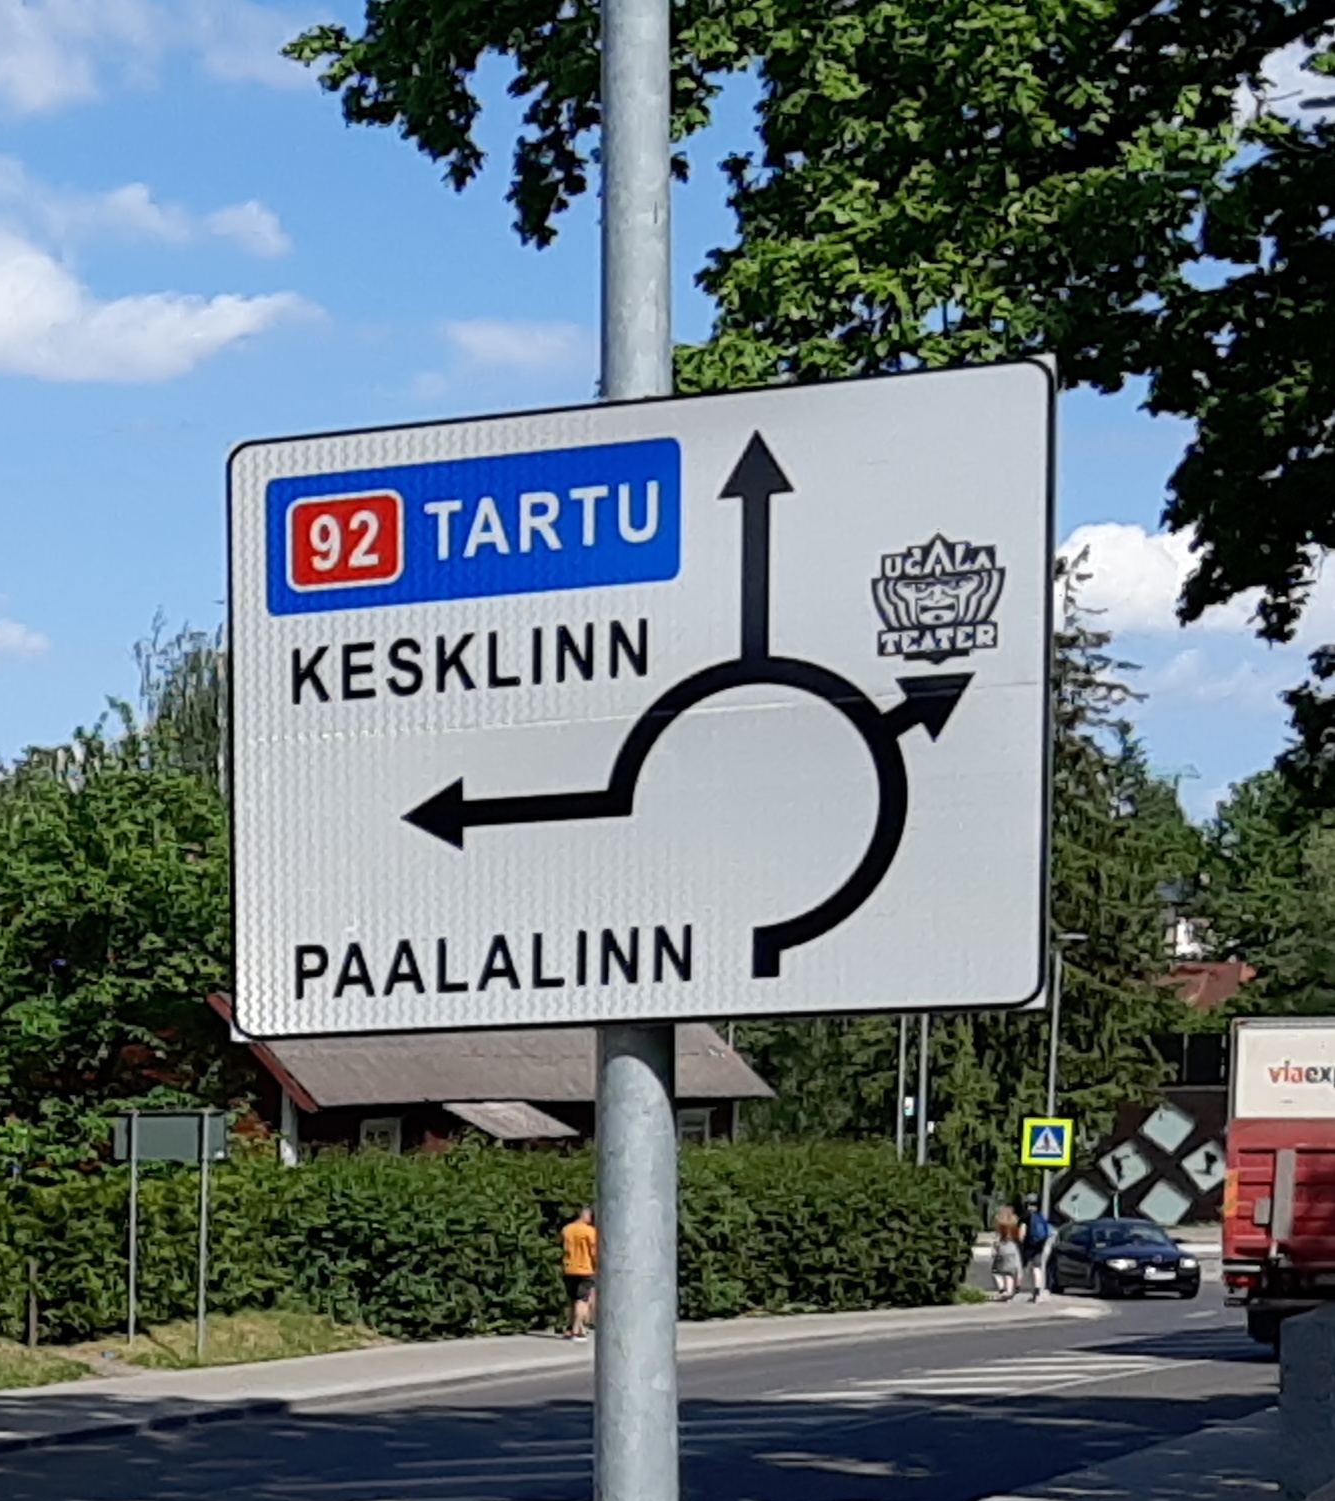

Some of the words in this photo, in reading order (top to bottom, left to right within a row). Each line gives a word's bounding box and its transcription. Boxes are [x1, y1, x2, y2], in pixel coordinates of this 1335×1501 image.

[308, 509, 379, 572] 92
[425, 481, 659, 560] TARTU
[292, 618, 648, 705] KESKLINN
[881, 624, 995, 655] TEATER
[296, 924, 692, 1000] PAALALINN
[1268, 1059, 1335, 1088] viaex
